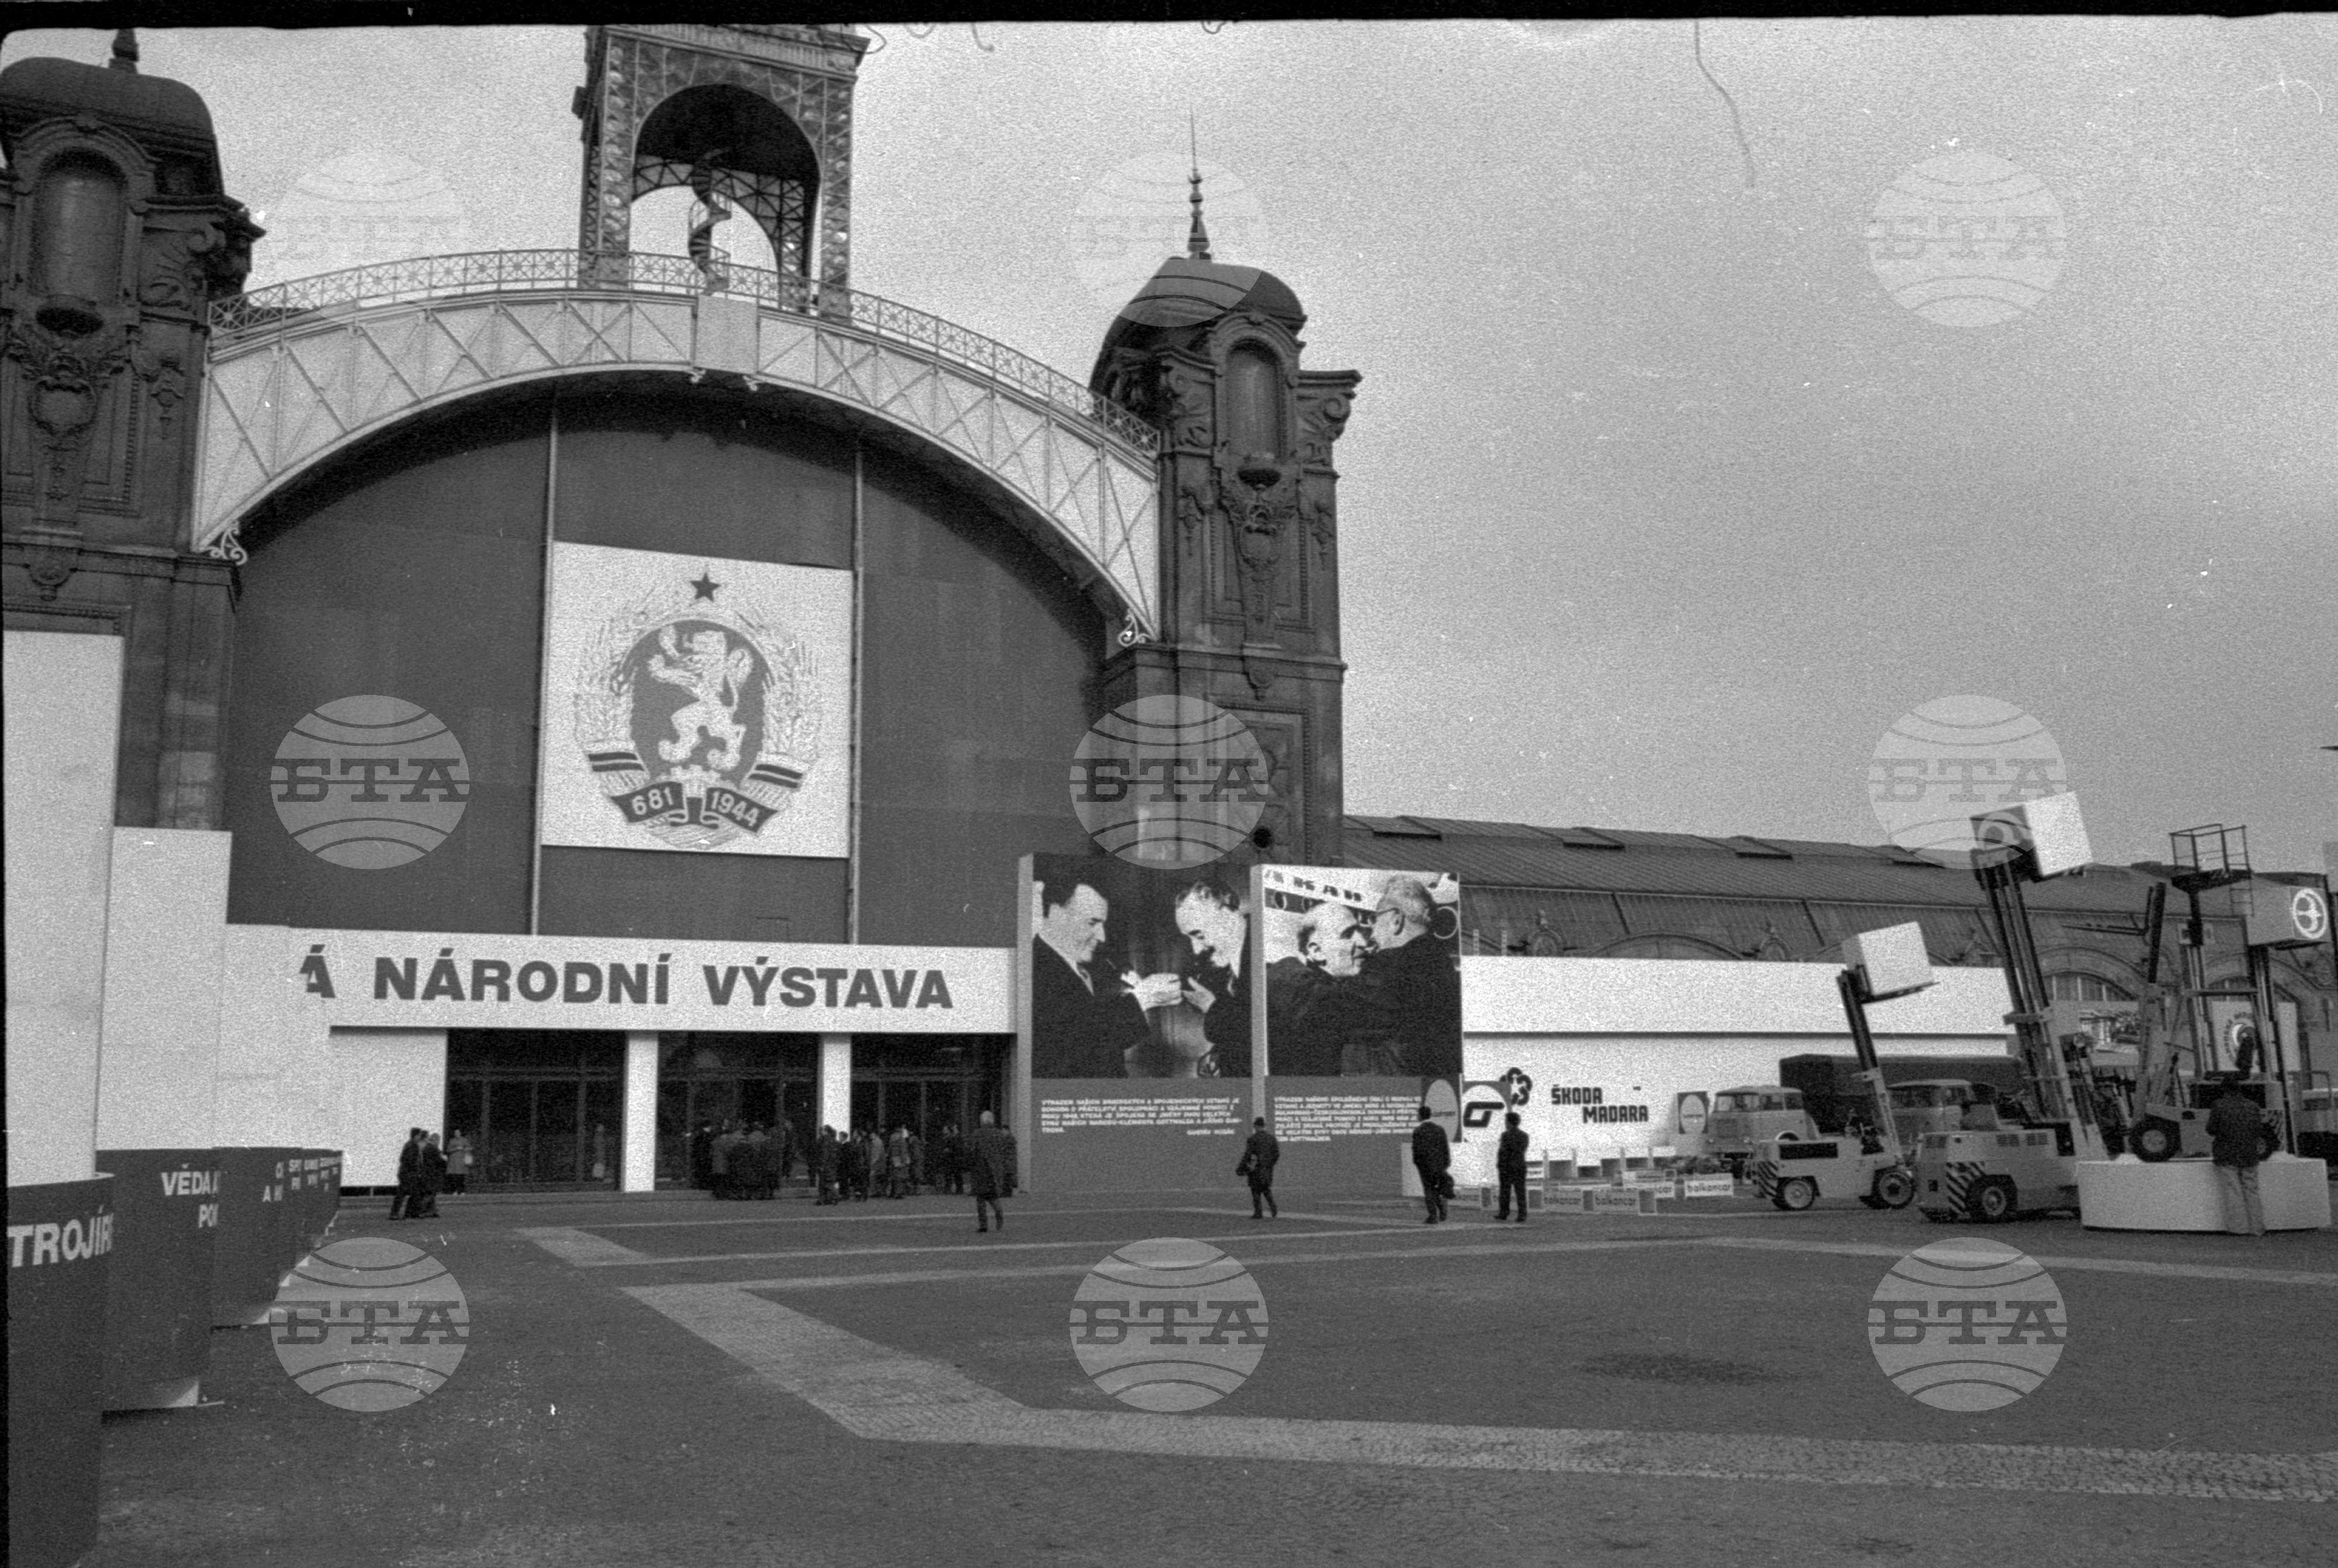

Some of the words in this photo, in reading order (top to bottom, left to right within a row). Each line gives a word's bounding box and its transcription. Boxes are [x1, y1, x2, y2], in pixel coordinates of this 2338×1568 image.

[631, 787, 675, 816] 681
[710, 791, 760, 826] 1944
[373, 948, 672, 1005] NÁRODNÍ
[703, 956, 953, 1009] VÝSTAVA
[1551, 1084, 1603, 1105] ŠKODA
[1582, 1105, 1649, 1124] MADARA
